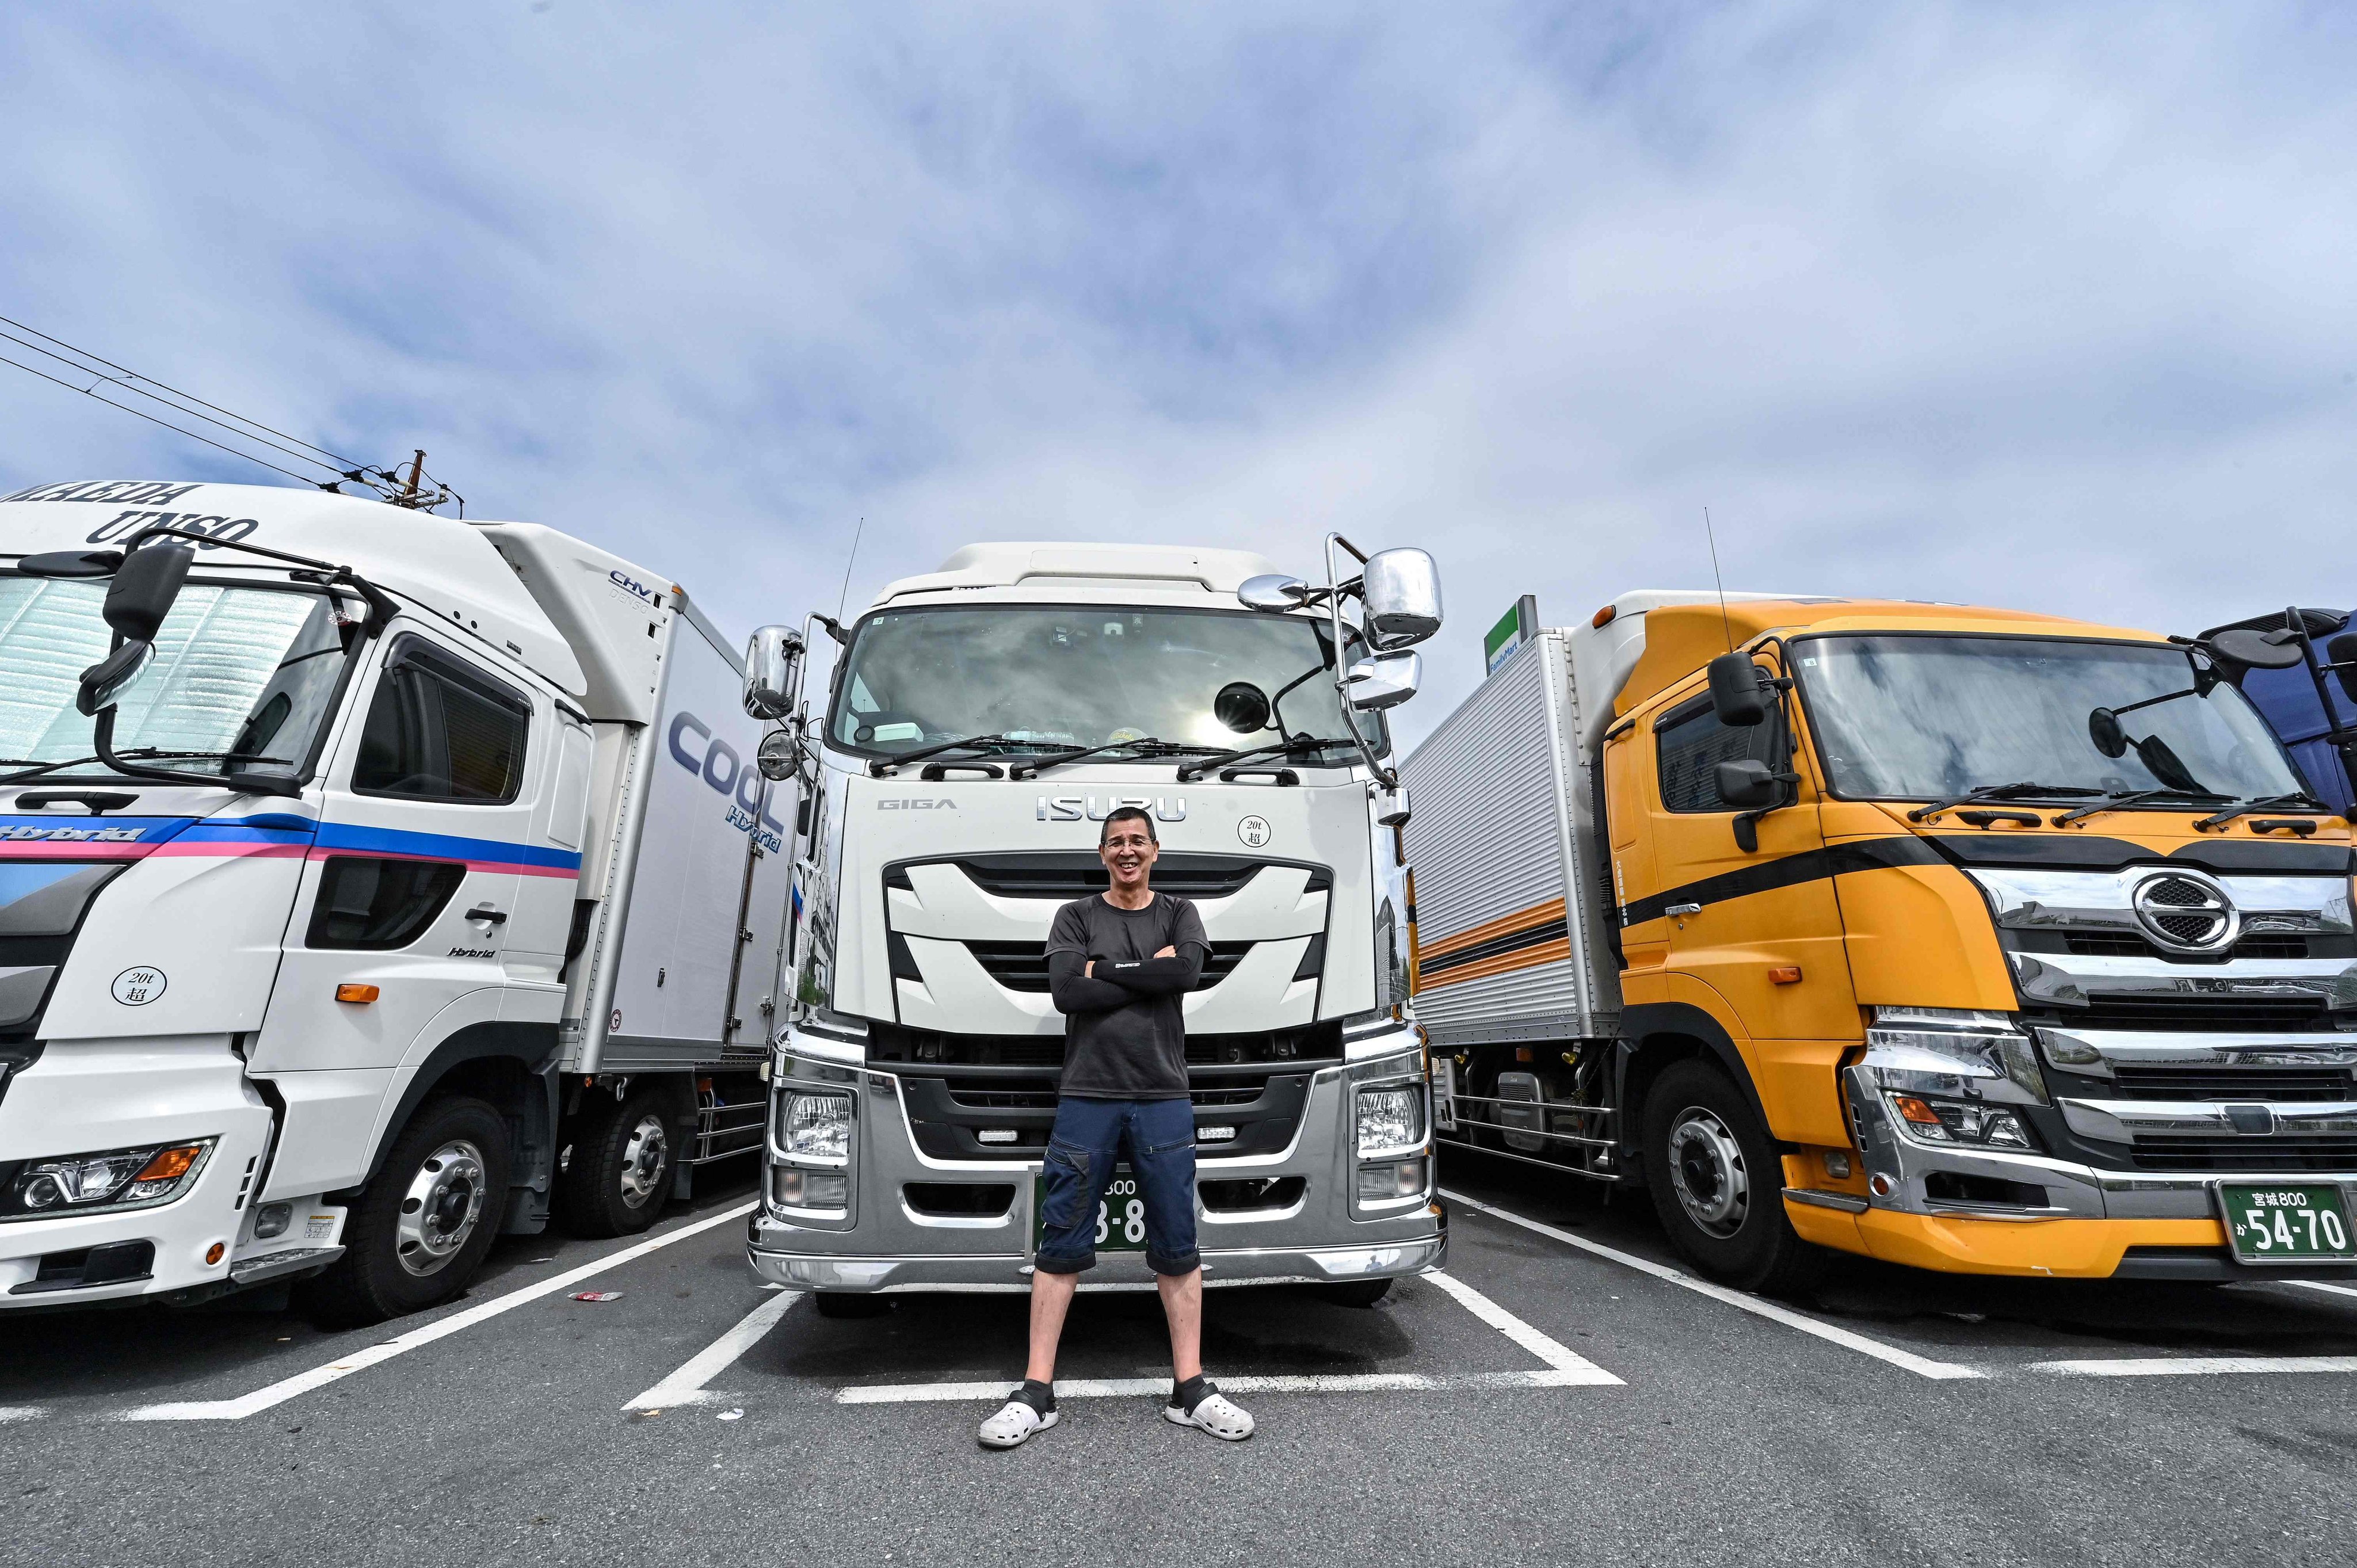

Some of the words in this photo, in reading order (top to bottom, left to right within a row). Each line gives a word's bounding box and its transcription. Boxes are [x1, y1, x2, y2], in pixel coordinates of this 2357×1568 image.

[86, 511, 258, 550] UNSO
[610, 570, 653, 597] CHV
[609, 588, 649, 614] DENSO
[1490, 641, 1518, 674] FamilyMart
[518, 697, 531, 707] HINO
[1656, 717, 1668, 725] HINO
[668, 710, 785, 836] COOL
[877, 799, 958, 810] GIGA
[725, 804, 783, 854] Hybrid
[1246, 820, 1263, 830] 20t
[0, 826, 147, 842] Hybrid
[1248, 832, 1261, 845] 超
[447, 947, 496, 958] Hybrid
[128, 972, 155, 984] 20t
[124, 987, 147, 1002] 超
[2236, 1223, 2248, 1237] か
[2245, 1210, 2347, 1250] 54-70
